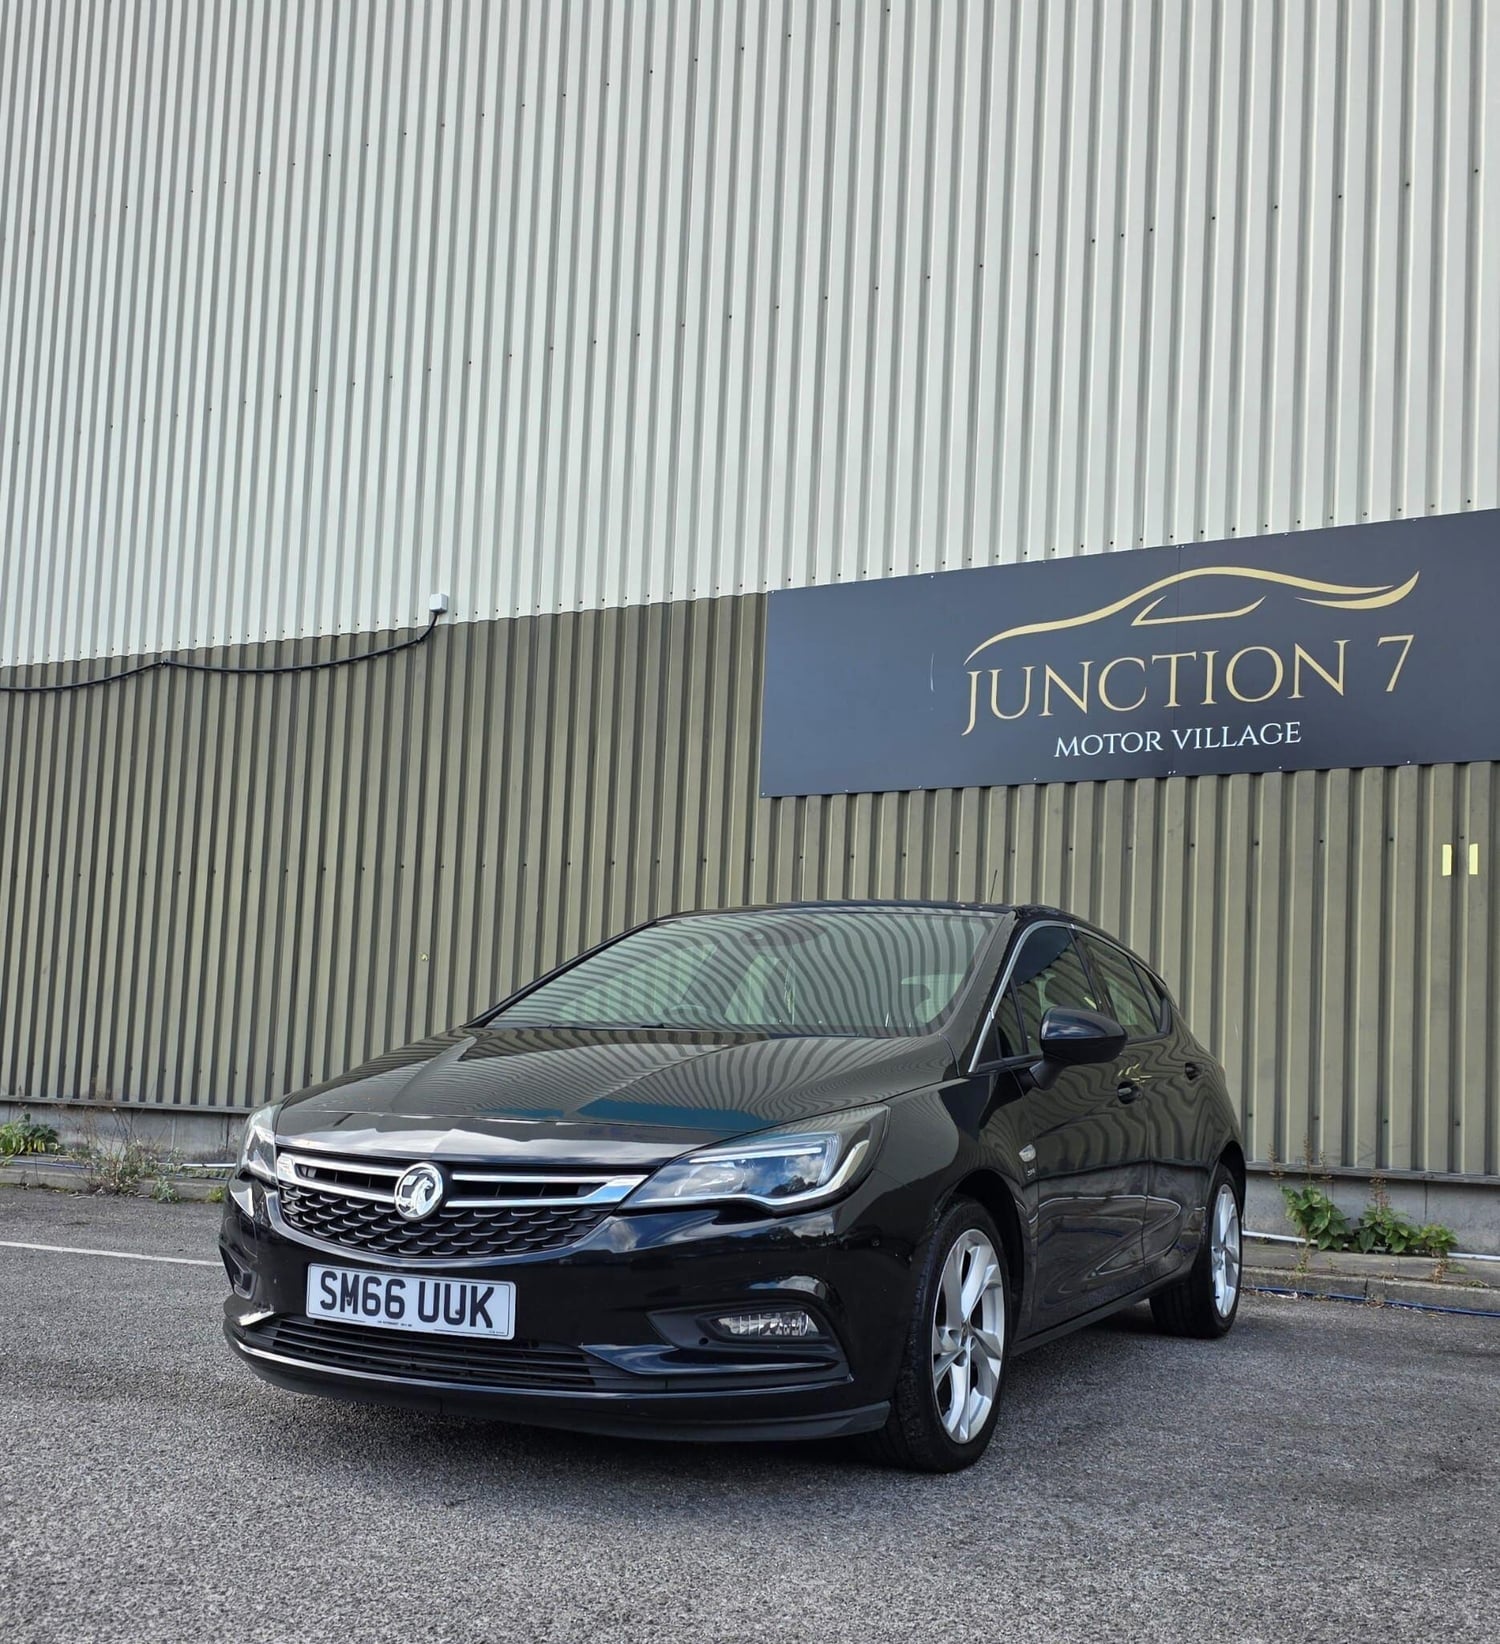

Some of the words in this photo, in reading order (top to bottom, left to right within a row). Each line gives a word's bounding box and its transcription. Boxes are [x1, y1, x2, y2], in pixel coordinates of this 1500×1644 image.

[961, 639, 1351, 736] JUNCTION
[1376, 634, 1415, 692] 7
[1054, 730, 1164, 758] MOTOR
[1171, 721, 1302, 750] VILLAGE
[320, 1270, 406, 1320] SM66
[418, 1281, 494, 1329] UUK
